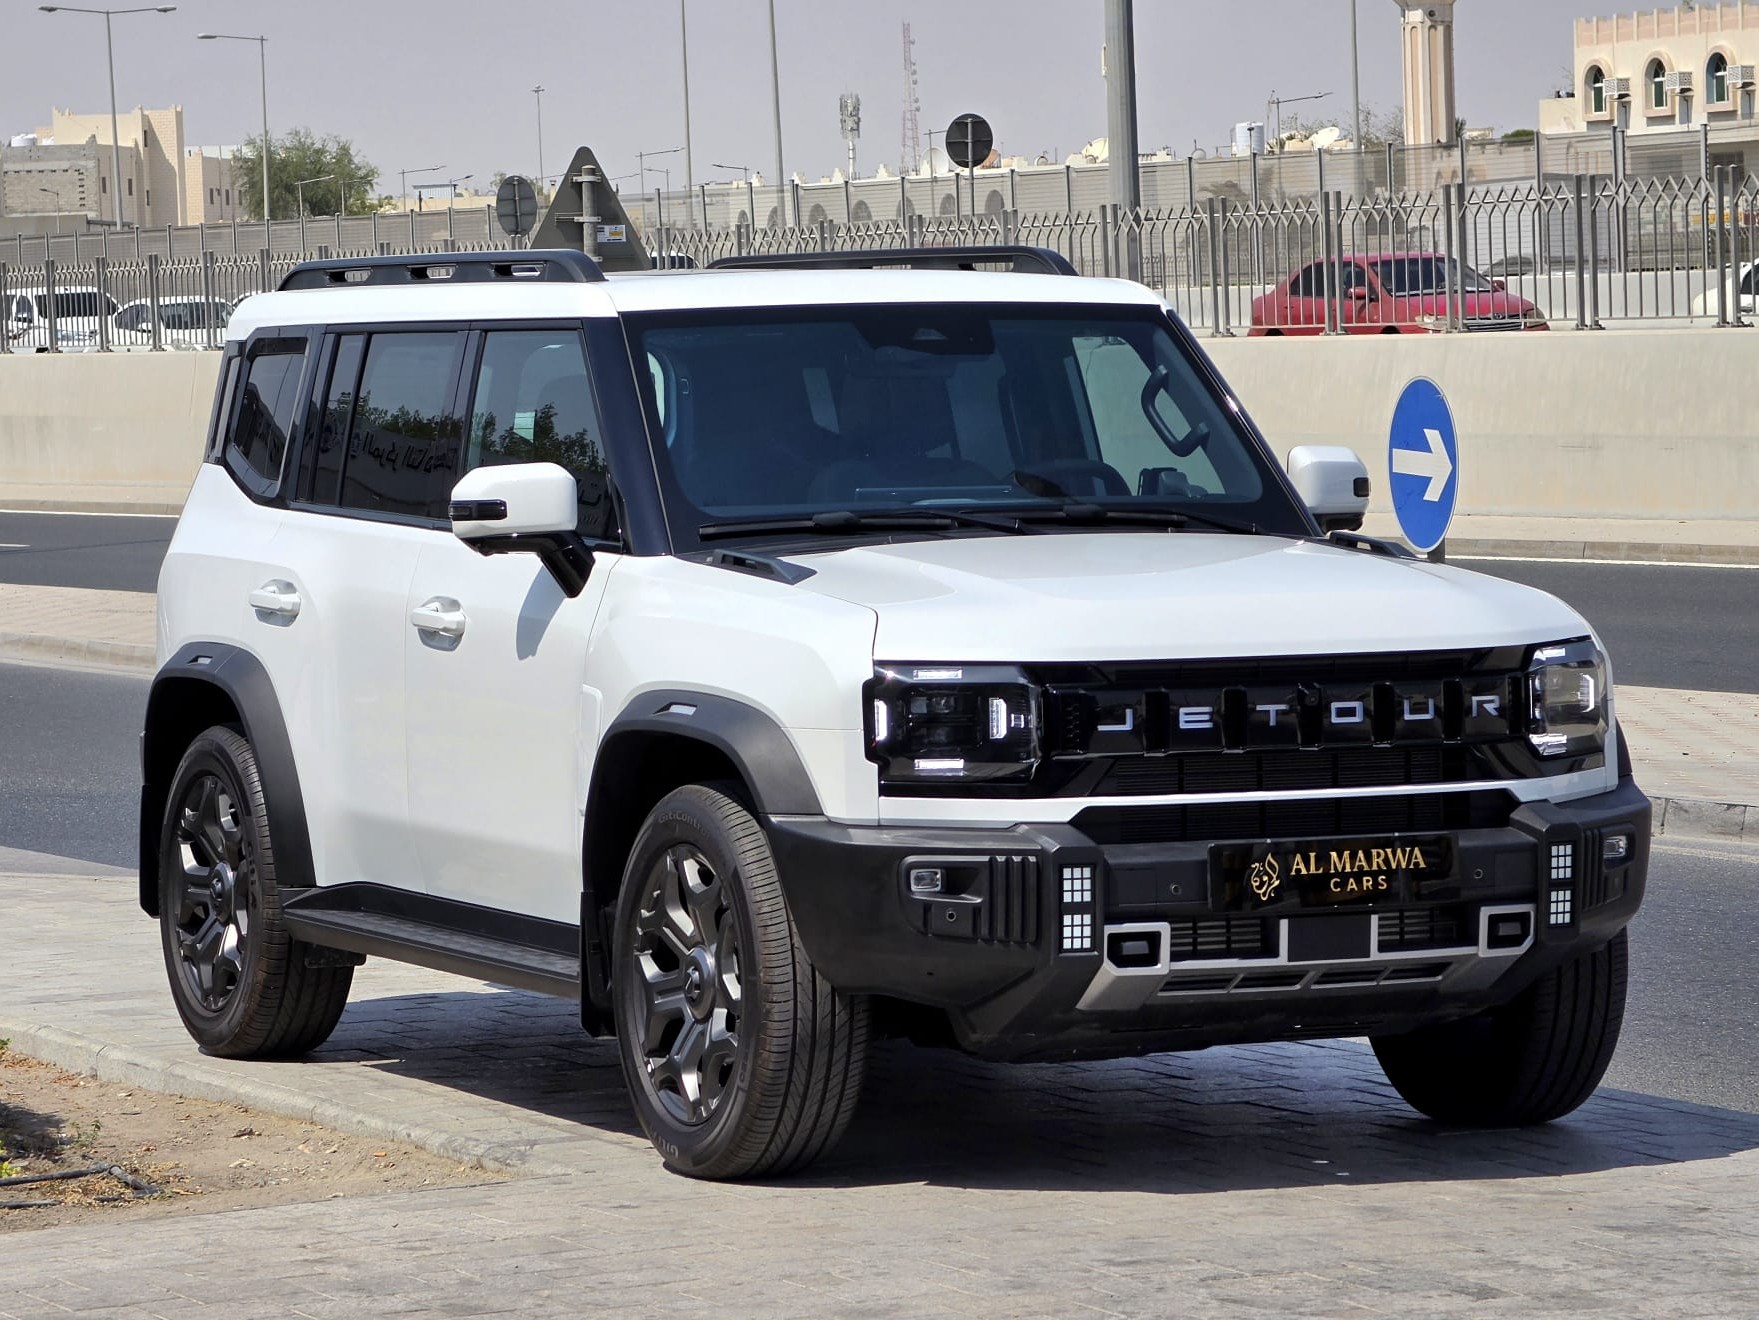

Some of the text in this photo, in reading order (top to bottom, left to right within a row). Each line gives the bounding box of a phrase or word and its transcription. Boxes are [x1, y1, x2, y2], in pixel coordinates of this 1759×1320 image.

[1097, 694, 1500, 731] JETOUR
[1289, 846, 1427, 875] AL MARWA
[1330, 875, 1388, 892] CARS
